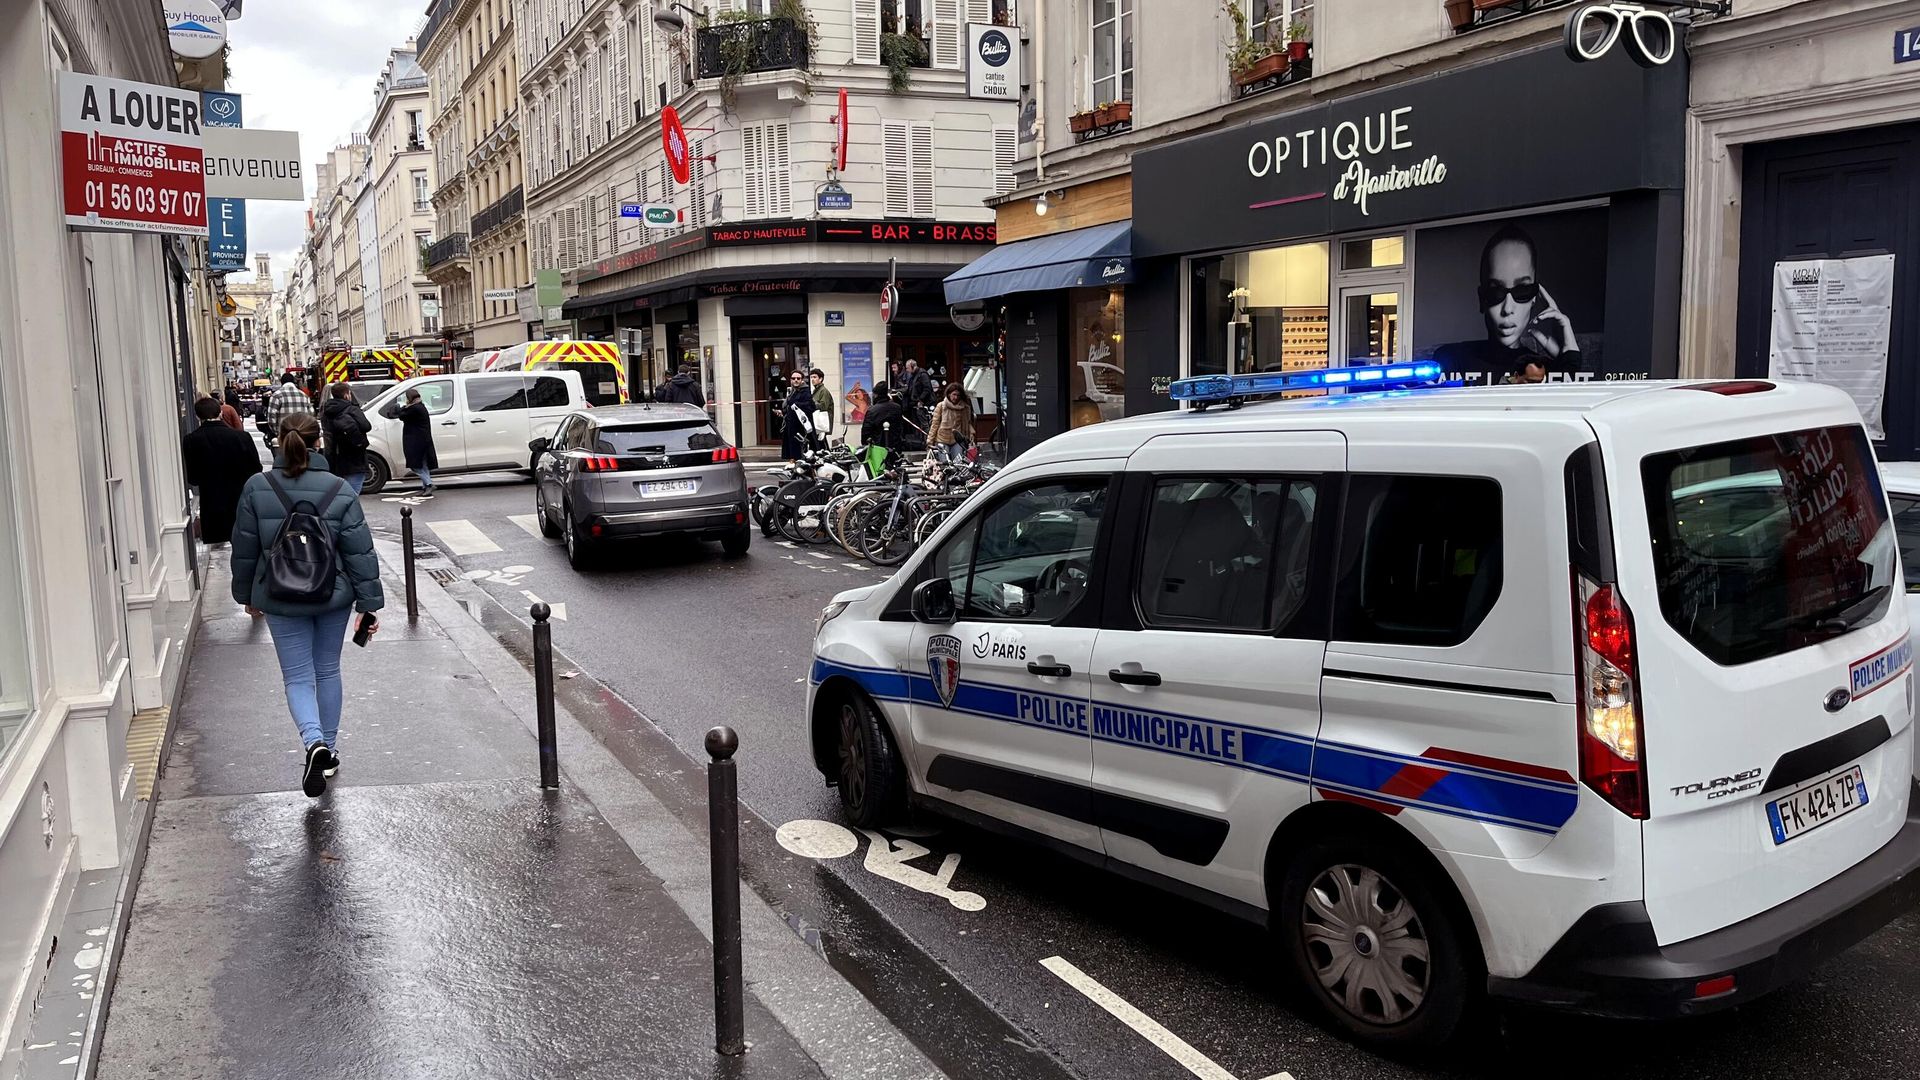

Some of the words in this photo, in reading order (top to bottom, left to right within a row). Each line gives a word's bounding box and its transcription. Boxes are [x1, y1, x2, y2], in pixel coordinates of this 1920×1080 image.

[184, 11, 222, 23] Hoquet
[985, 72, 1005, 81] cantine
[983, 85, 1007, 95] CHOUX
[81, 85, 101, 121] A
[110, 88, 200, 136] LOUER
[114, 140, 167, 157] ACTIFS
[1248, 106, 1413, 177] OPTIQUE
[87, 164, 115, 174] BUREAUX
[118, 168, 153, 178] COMMERCES
[114, 152, 201, 174] IMMOBILIER
[1333, 155, 1447, 216] d'Hauteville
[85, 180, 104, 208] 01
[111, 183, 131, 211] 56
[135, 186, 156, 213] 03
[160, 188, 179, 215] 97
[183, 191, 201, 217] 07
[115, 220, 135, 229] offres
[871, 224, 910, 239] BAR
[933, 225, 996, 240] BRASS
[713, 231, 742, 241] TABAC
[709, 283, 738, 294] Tabac
[742, 280, 801, 293] d'Hauteville
[929, 638, 960, 652] POLICE
[929, 647, 958, 658] MUNICIPALE
[991, 642, 1027, 660] PARIS
[1853, 656, 1886, 692] POLICE
[1020, 694, 1088, 731] POLICE
[1093, 707, 1237, 760] MUNICIPALE
[1670, 767, 1762, 796] TOURNEO
[1707, 778, 1764, 799] CONNECT
